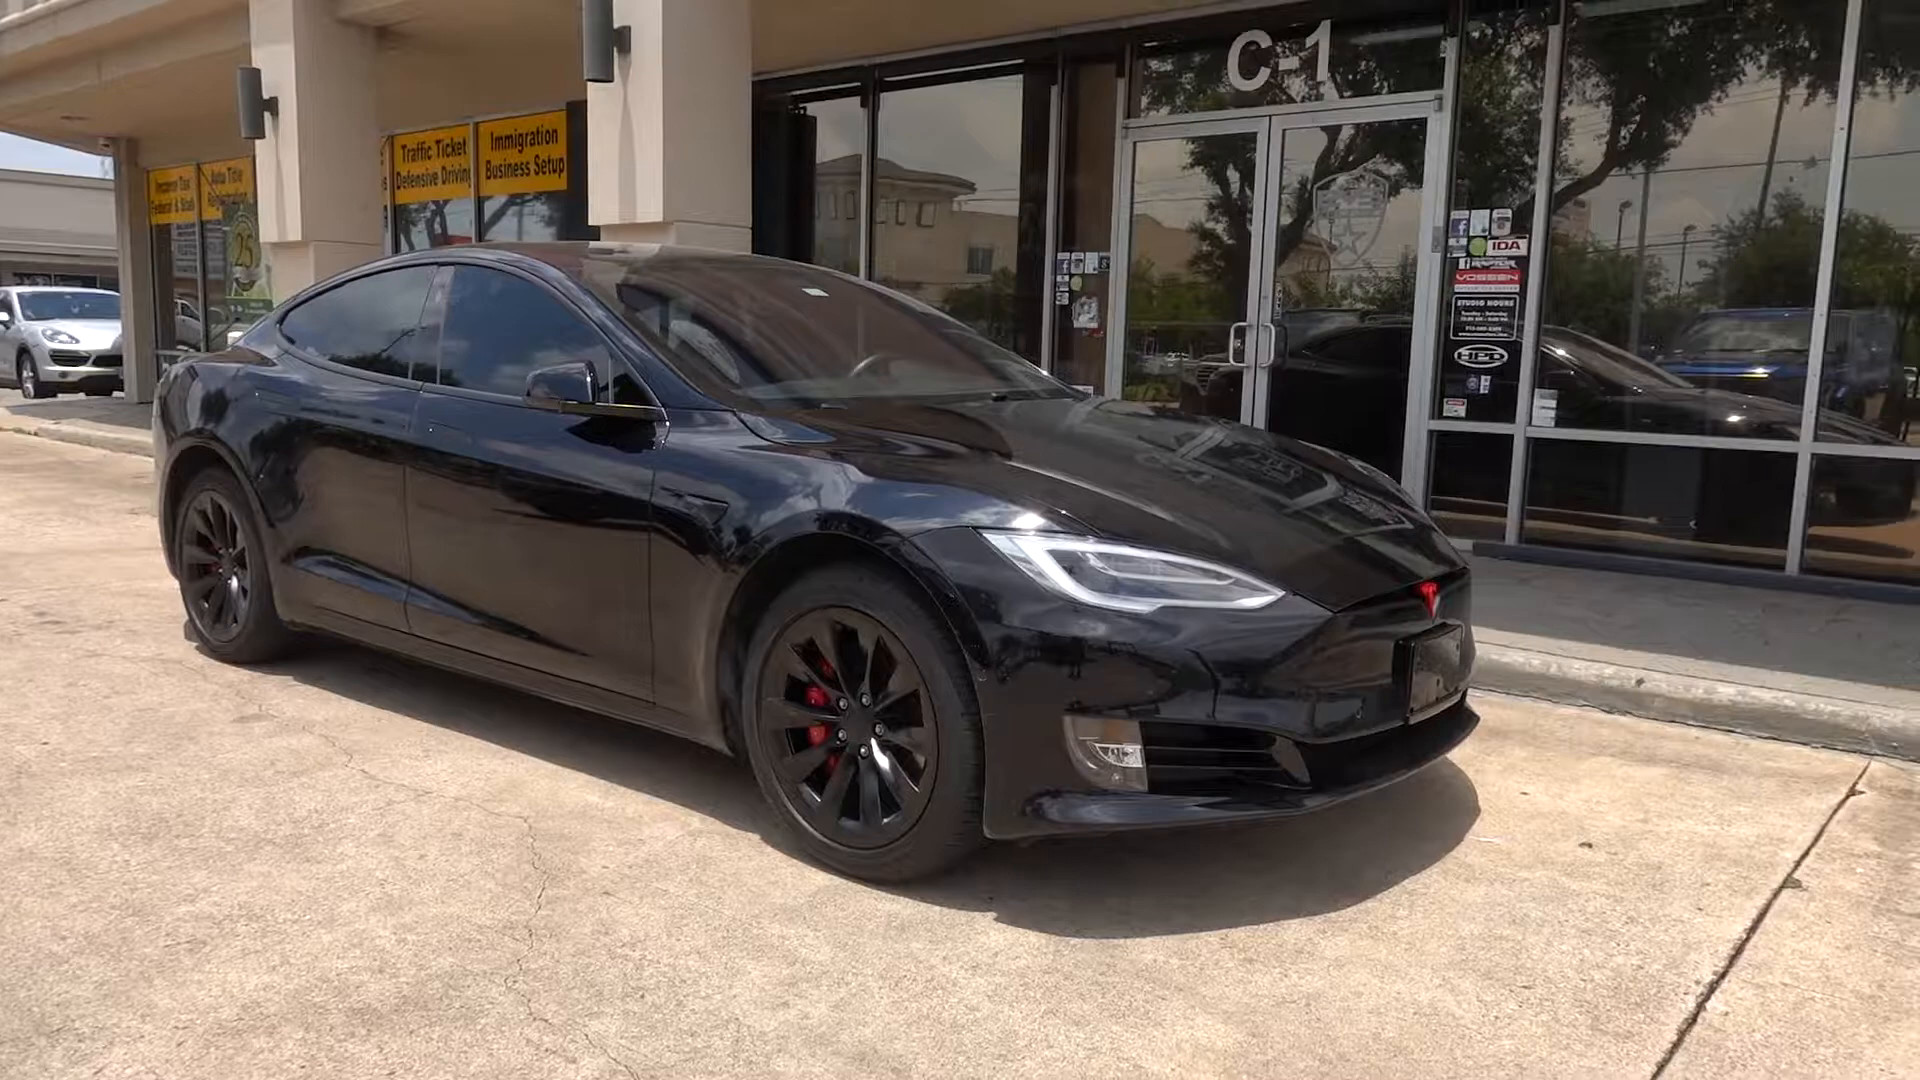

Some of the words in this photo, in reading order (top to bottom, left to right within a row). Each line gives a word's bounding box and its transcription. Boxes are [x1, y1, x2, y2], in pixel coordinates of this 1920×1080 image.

[1227, 20, 1331, 91] C-1
[401, 139, 433, 164] Traffic
[435, 135, 468, 159] Ticket
[490, 124, 559, 154] Immigration
[396, 167, 439, 191] Defensive
[441, 163, 472, 189] Driving
[485, 158, 531, 181] Business
[533, 154, 566, 180] Setup
[234, 231, 254, 268] 25
[1492, 241, 1521, 251] IDA
[1455, 273, 1519, 282] VOSSEN
[1456, 299, 1485, 307] STUDIO
[1486, 299, 1515, 307] HOURS
